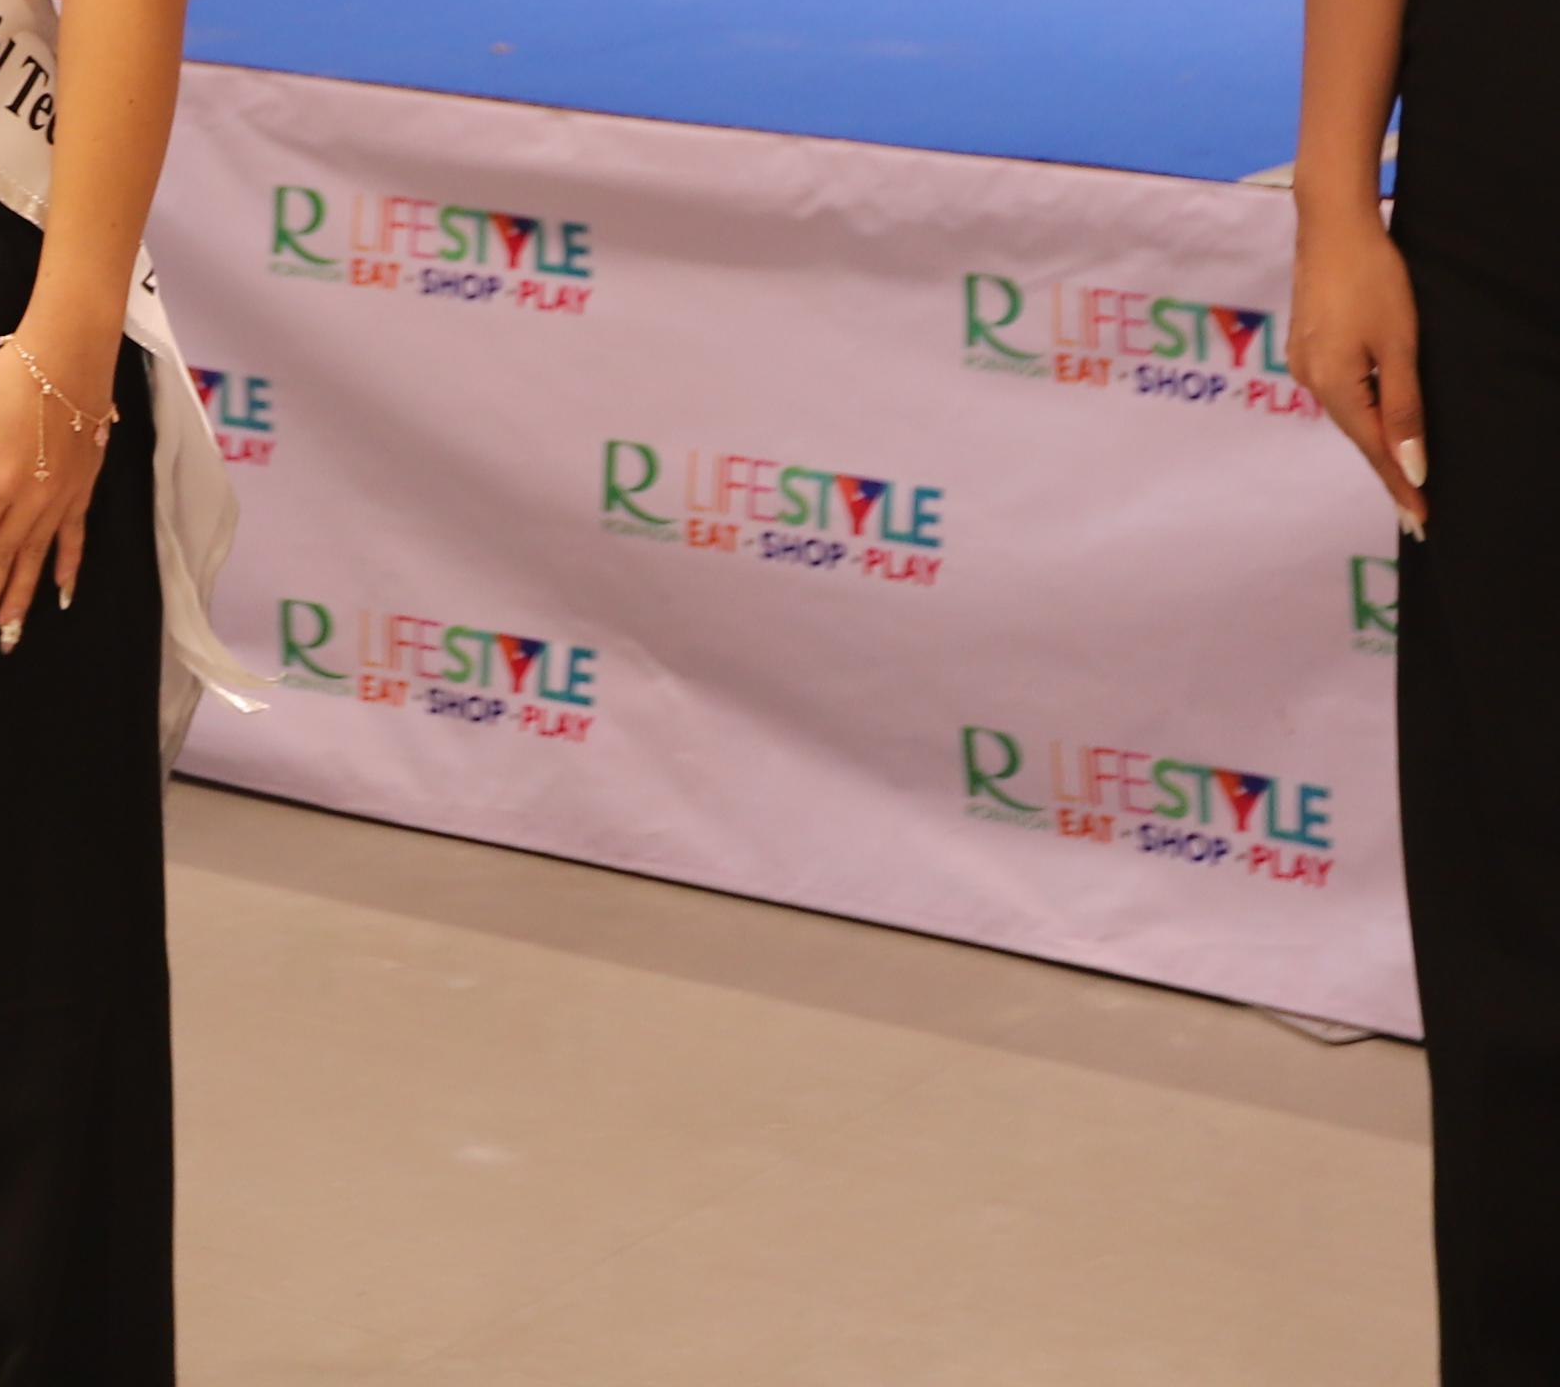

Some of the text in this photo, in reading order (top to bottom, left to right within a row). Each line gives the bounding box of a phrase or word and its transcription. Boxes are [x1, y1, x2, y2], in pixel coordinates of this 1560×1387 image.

[271, 186, 592, 278] R LIFESTYLE
[350, 258, 400, 289] EAT
[421, 268, 501, 301] SHOP
[516, 280, 592, 315] PLAY
[964, 273, 1290, 375] R LIFESTYL
[1053, 353, 1112, 387] EAT
[1134, 364, 1227, 403] SHOP
[216, 432, 277, 466] LAY
[602, 439, 943, 548] R LIFESTYLE
[686, 518, 740, 553] EAT
[761, 531, 846, 568] SHOP
[862, 547, 942, 586] PLAY
[278, 598, 596, 707] R LIFESTYLE
[357, 674, 409, 708] EAT
[425, 687, 506, 724] SHOP
[520, 705, 594, 743] PLAY
[962, 725, 1332, 849] R LIFESTYLE
[1055, 808, 1115, 844] EAT
[1136, 823, 1229, 866] SHOP
[1248, 844, 1333, 888] PLAY
